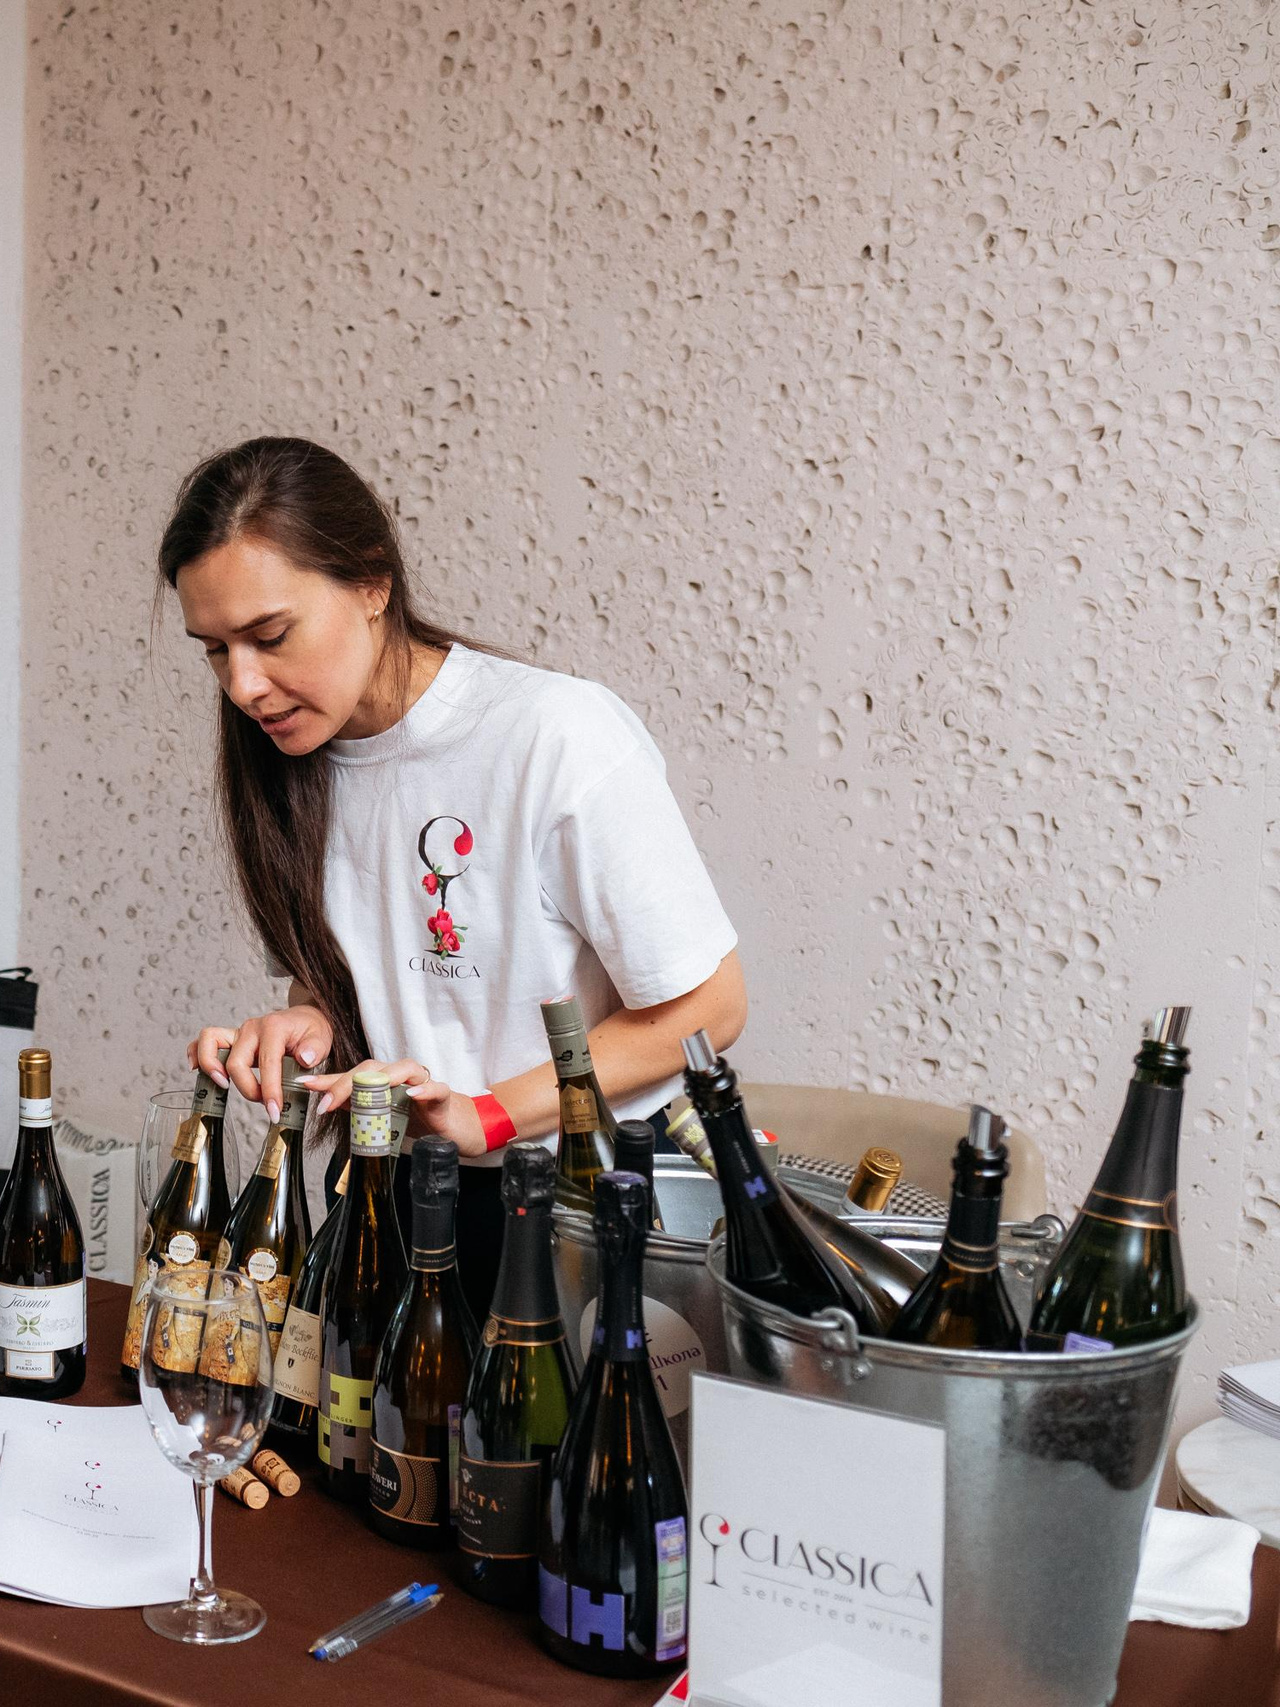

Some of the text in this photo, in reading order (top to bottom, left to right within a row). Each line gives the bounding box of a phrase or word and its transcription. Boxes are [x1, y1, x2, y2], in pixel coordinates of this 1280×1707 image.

[409, 956, 480, 979] CLASSICA
[0, 1293, 51, 1309] Jasmin
[740, 1527, 934, 1607] CLASSICA
[742, 1585, 931, 1644] selected wine
